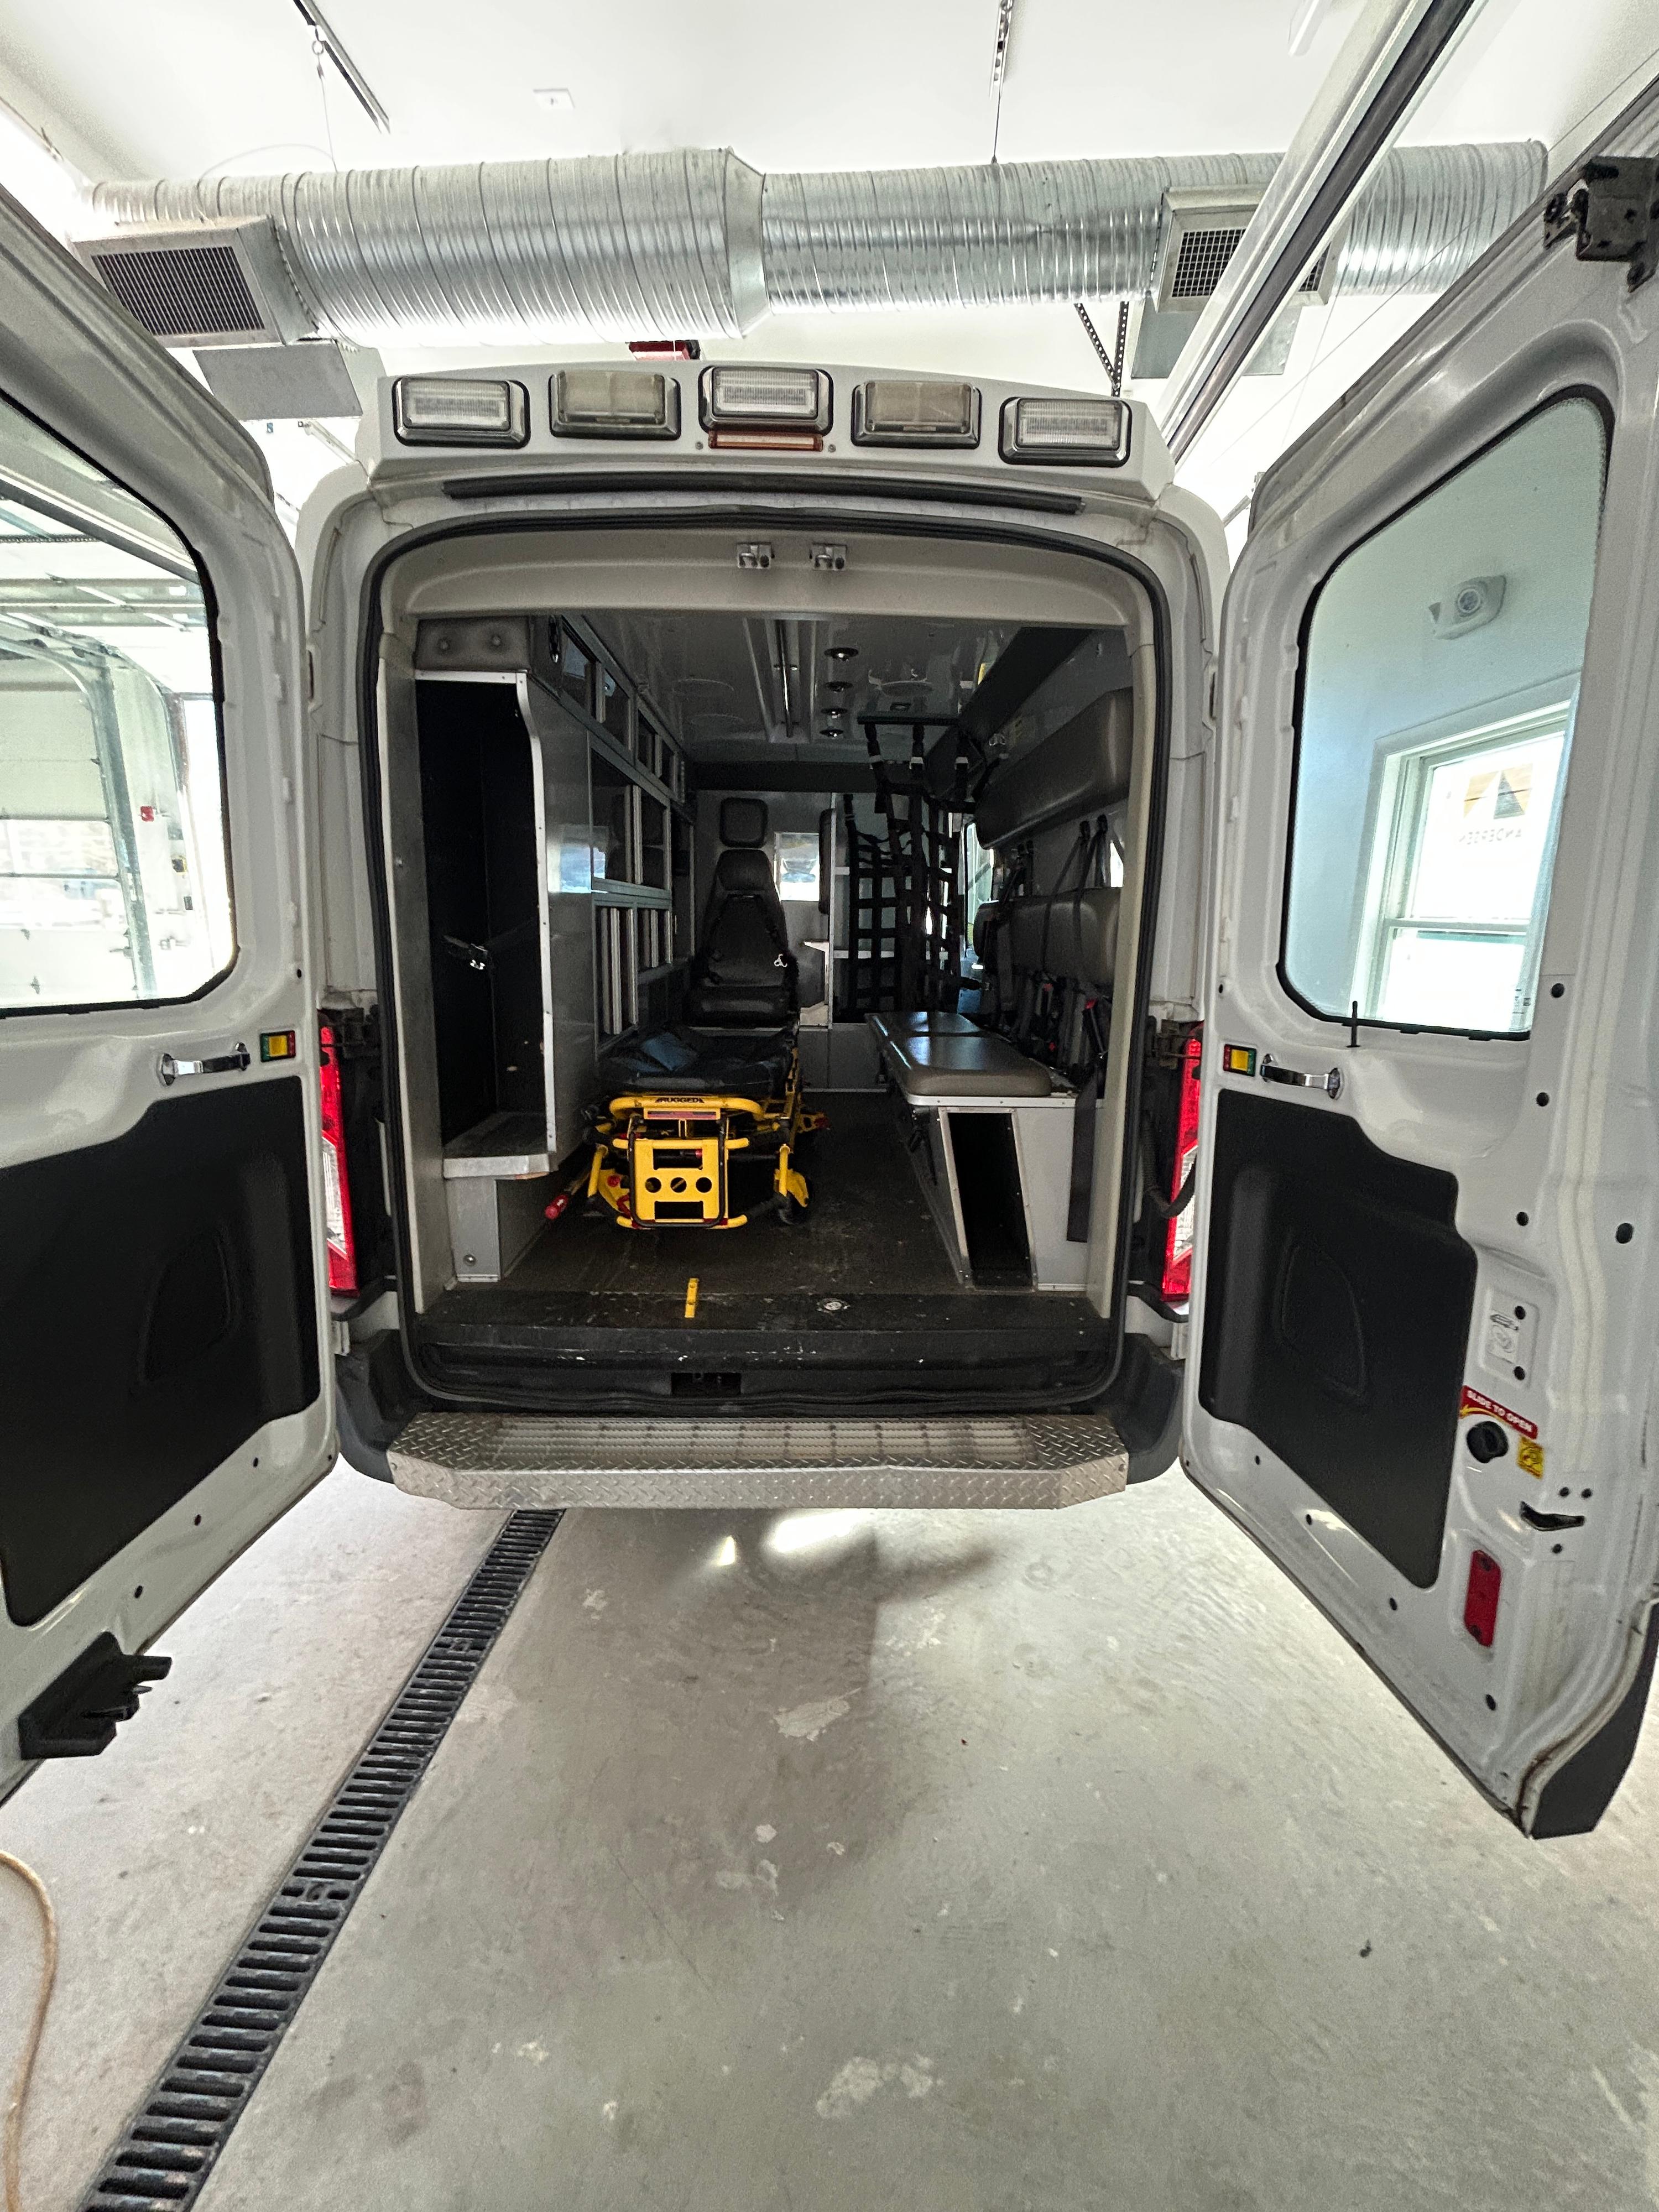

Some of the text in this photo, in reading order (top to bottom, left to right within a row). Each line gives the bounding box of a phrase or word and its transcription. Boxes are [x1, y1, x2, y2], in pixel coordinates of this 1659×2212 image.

[1467, 1390, 1532, 1432] SLIDE TO OPEN
